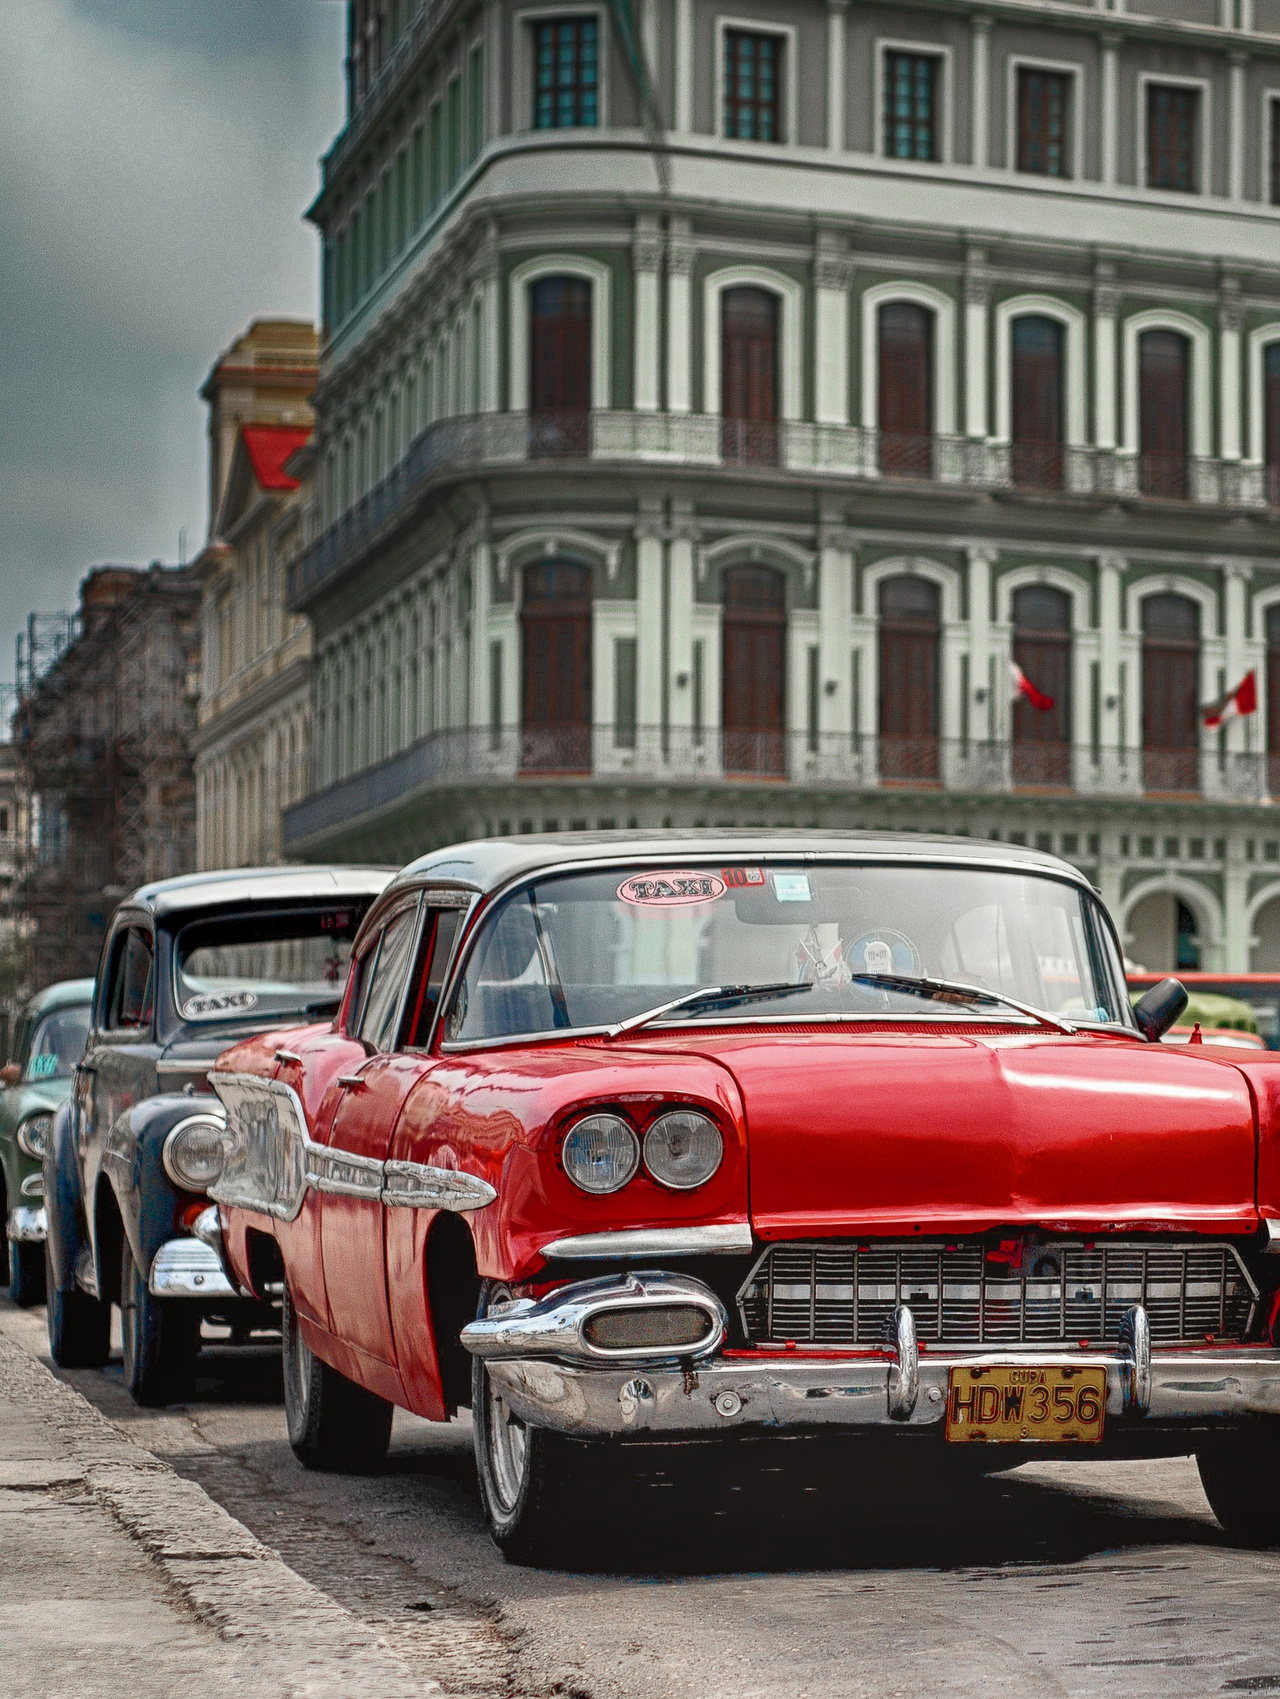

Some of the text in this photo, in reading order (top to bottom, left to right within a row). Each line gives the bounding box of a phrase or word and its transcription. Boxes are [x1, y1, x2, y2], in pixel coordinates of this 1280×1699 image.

[724, 869, 747, 886] 10
[630, 879, 714, 899] TAXI
[192, 993, 249, 1012] TAXI
[1009, 1370, 1047, 1384] CUBA
